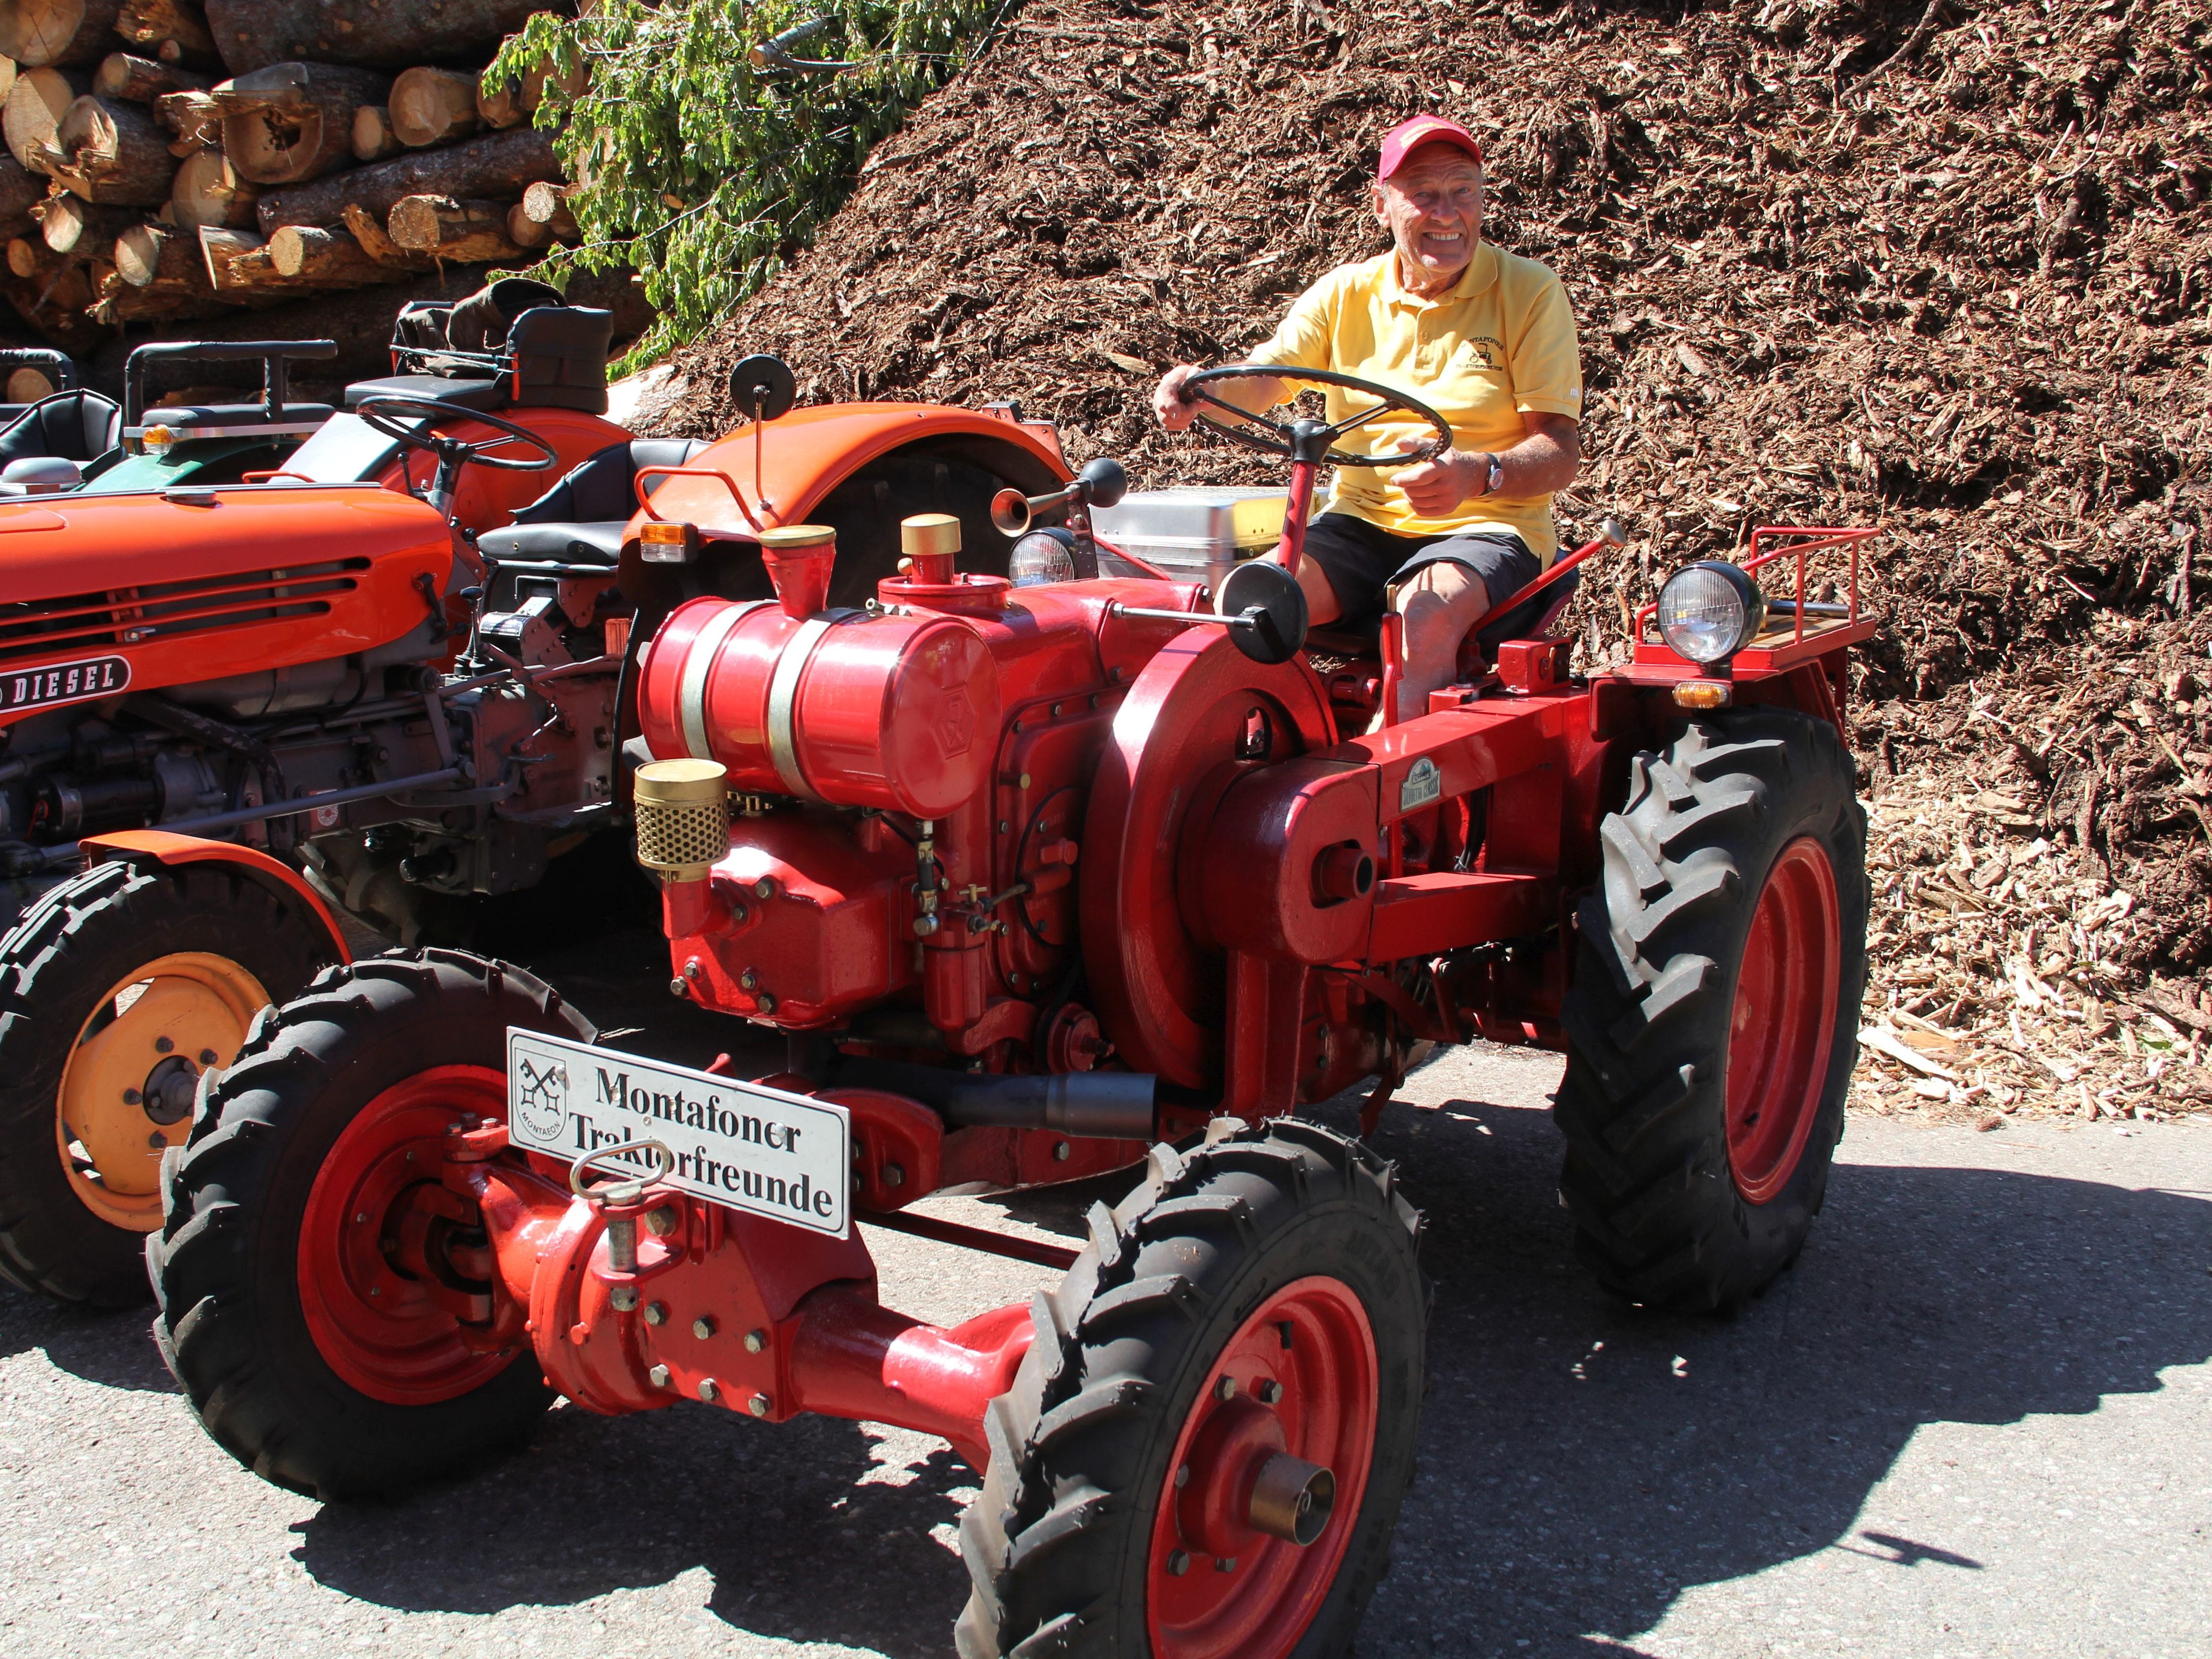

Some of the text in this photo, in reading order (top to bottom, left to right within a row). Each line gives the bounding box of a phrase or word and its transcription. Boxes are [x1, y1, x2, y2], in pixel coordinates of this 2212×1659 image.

[1461, 337, 1504, 351] MNTAFONER
[13, 663, 114, 703] DIESEL
[596, 1067, 801, 1154] Montafoner
[569, 1112, 832, 1217] Traktorfreunde
